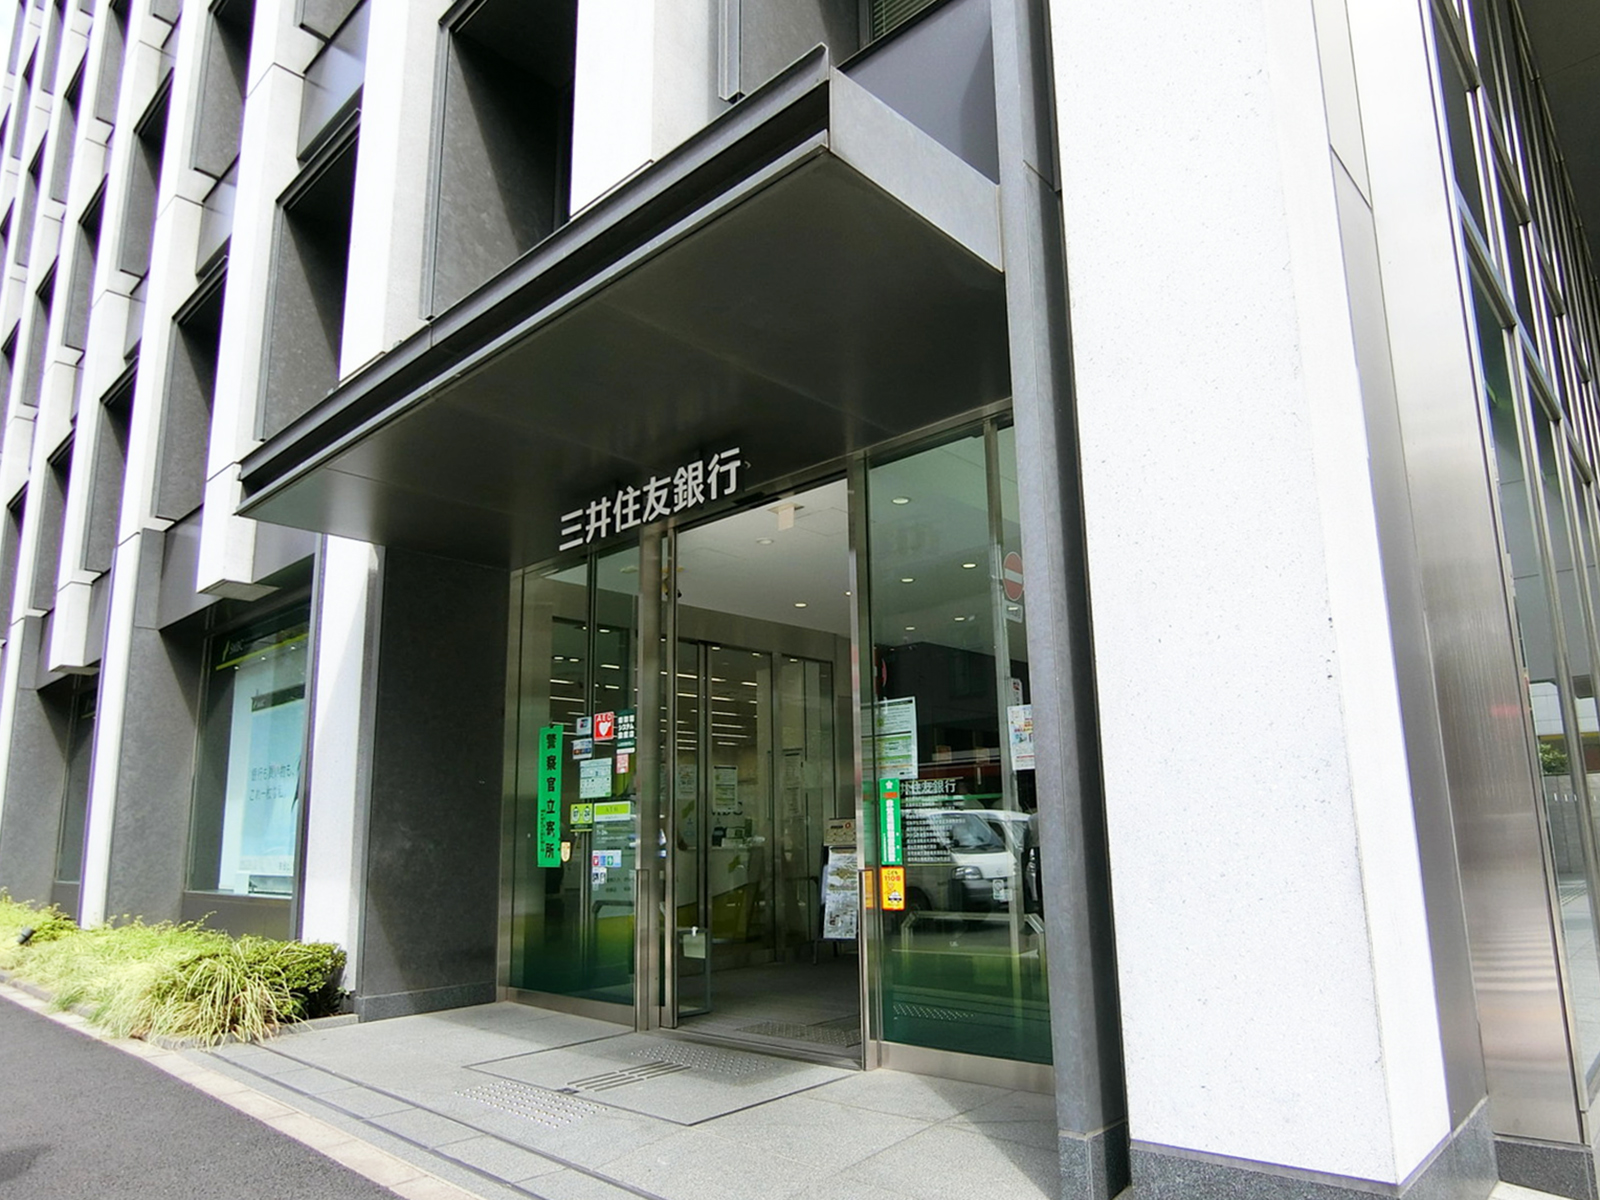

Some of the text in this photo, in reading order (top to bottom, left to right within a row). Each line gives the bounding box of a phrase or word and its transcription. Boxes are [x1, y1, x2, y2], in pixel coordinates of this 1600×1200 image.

[559, 447, 741, 551] 三井住友銀行
[596, 713, 613, 722] AED
[546, 734, 557, 859] 警察官立寄所
